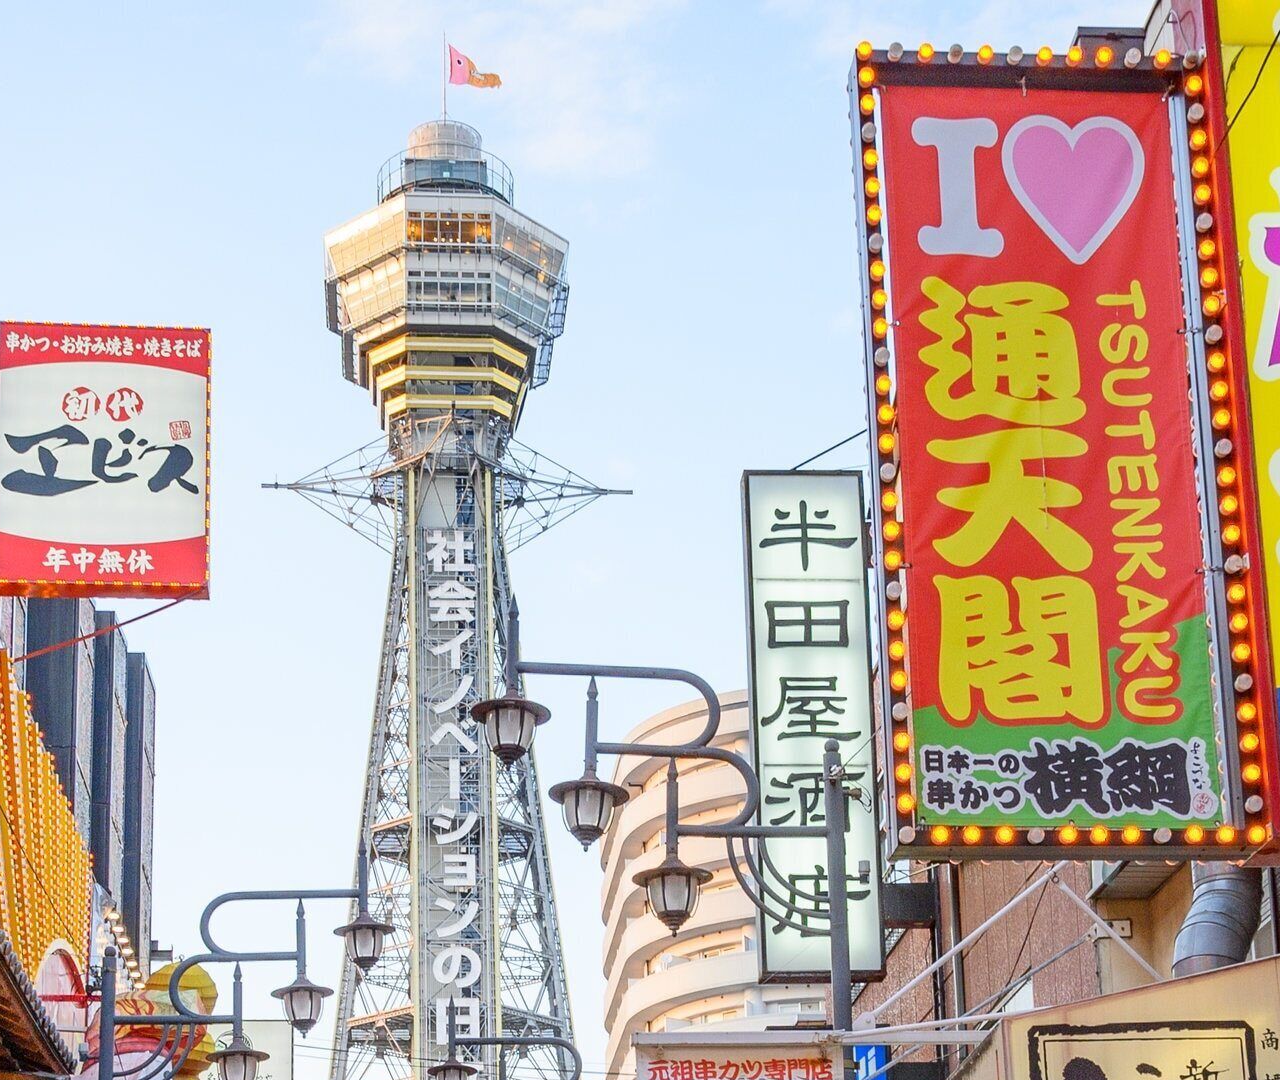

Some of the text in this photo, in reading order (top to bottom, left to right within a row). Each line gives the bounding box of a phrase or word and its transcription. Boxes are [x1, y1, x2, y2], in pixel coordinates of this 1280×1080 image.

[5, 331, 202, 358] 串かつ・お好み焼き・焼きそば
[1, 424, 199, 497] エビス
[919, 277, 1108, 725] 通天閣
[1095, 280, 1181, 721] TSUTENKAKU
[42, 547, 155, 576] 年中無休
[759, 499, 870, 938] 半田屋酒店
[924, 750, 1020, 775] 日本一の
[926, 778, 1021, 811] 串かつ
[1022, 741, 1191, 816] 横綱
